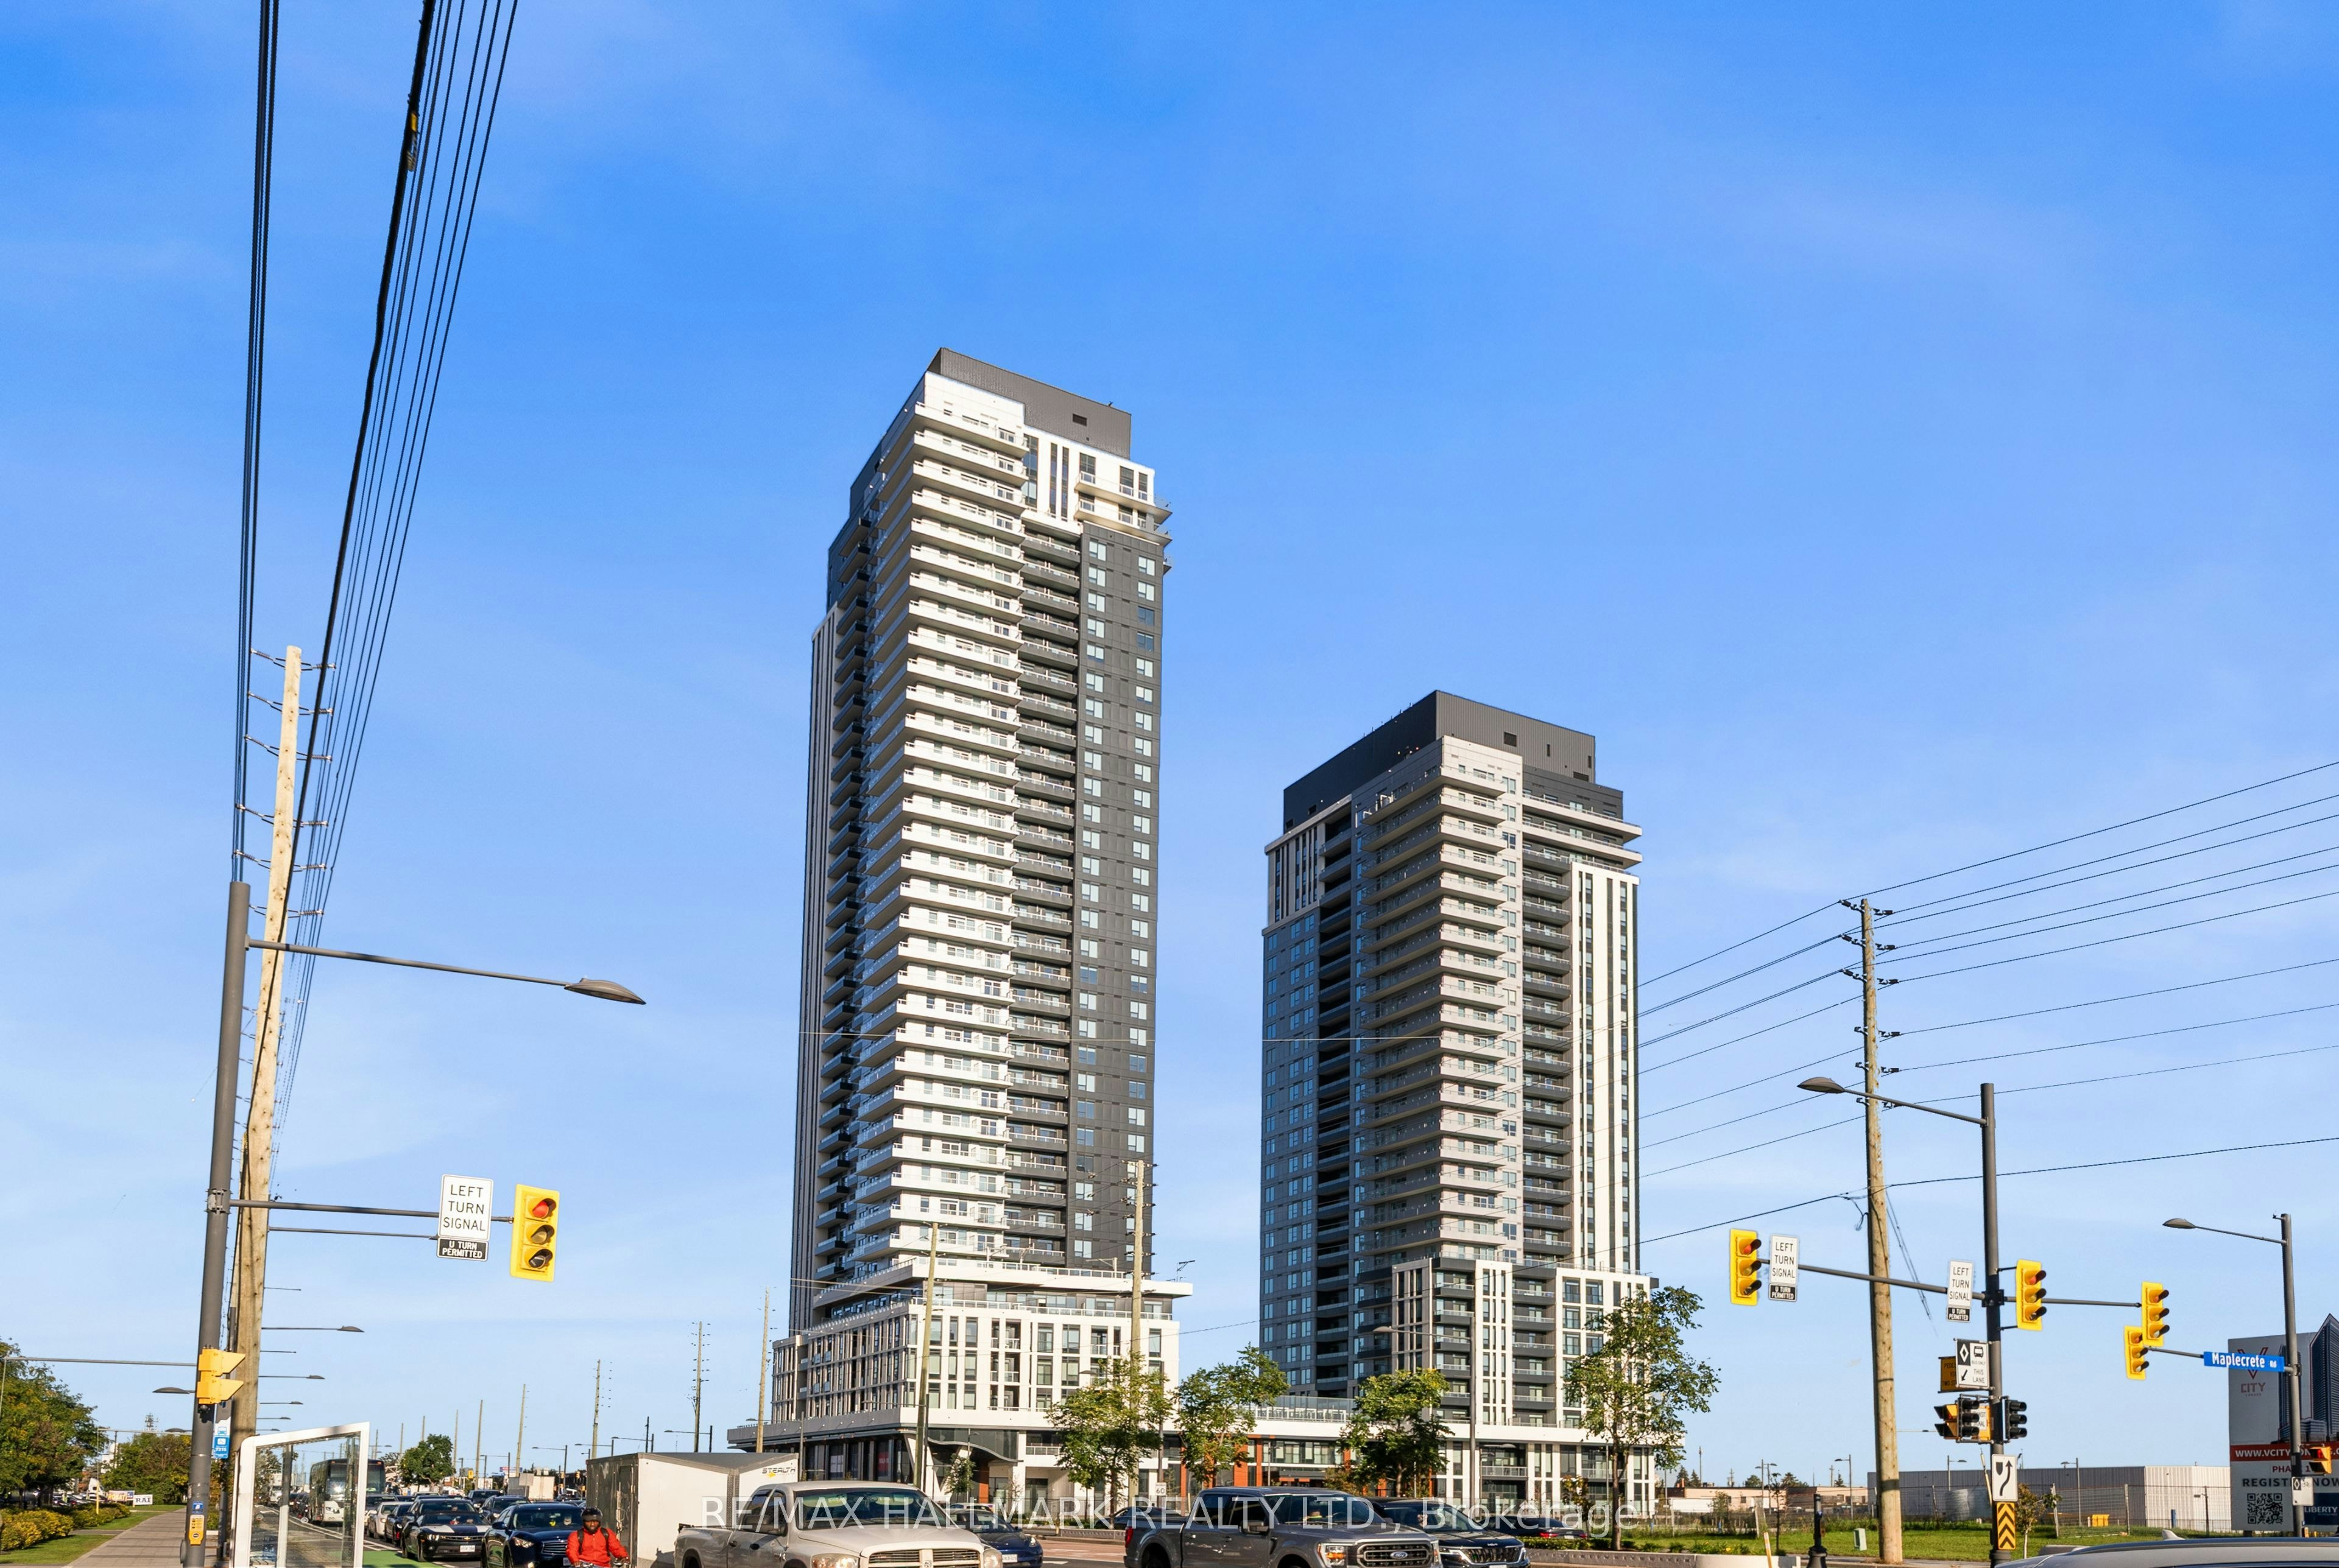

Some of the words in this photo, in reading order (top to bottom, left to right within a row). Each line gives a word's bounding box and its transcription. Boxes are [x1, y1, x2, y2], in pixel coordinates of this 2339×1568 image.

[451, 1184, 483, 1198] LEFT
[448, 1201, 484, 1215] TURN
[443, 1217, 485, 1231] SIGNAL
[458, 1241, 477, 1250] TURN
[1776, 1242, 1793, 1252] LEFT
[442, 1248, 482, 1259] PERMITTED
[1774, 1255, 1794, 1265] TURN
[1772, 1267, 1795, 1278] SIGNAL
[1953, 1267, 1969, 1276] LEFT
[1952, 1279, 1970, 1289] TURN
[1949, 1291, 1970, 1301] SIGNAL
[2212, 1352, 2265, 1368] Maplecrete
[2240, 1382, 2266, 1393] CITY
